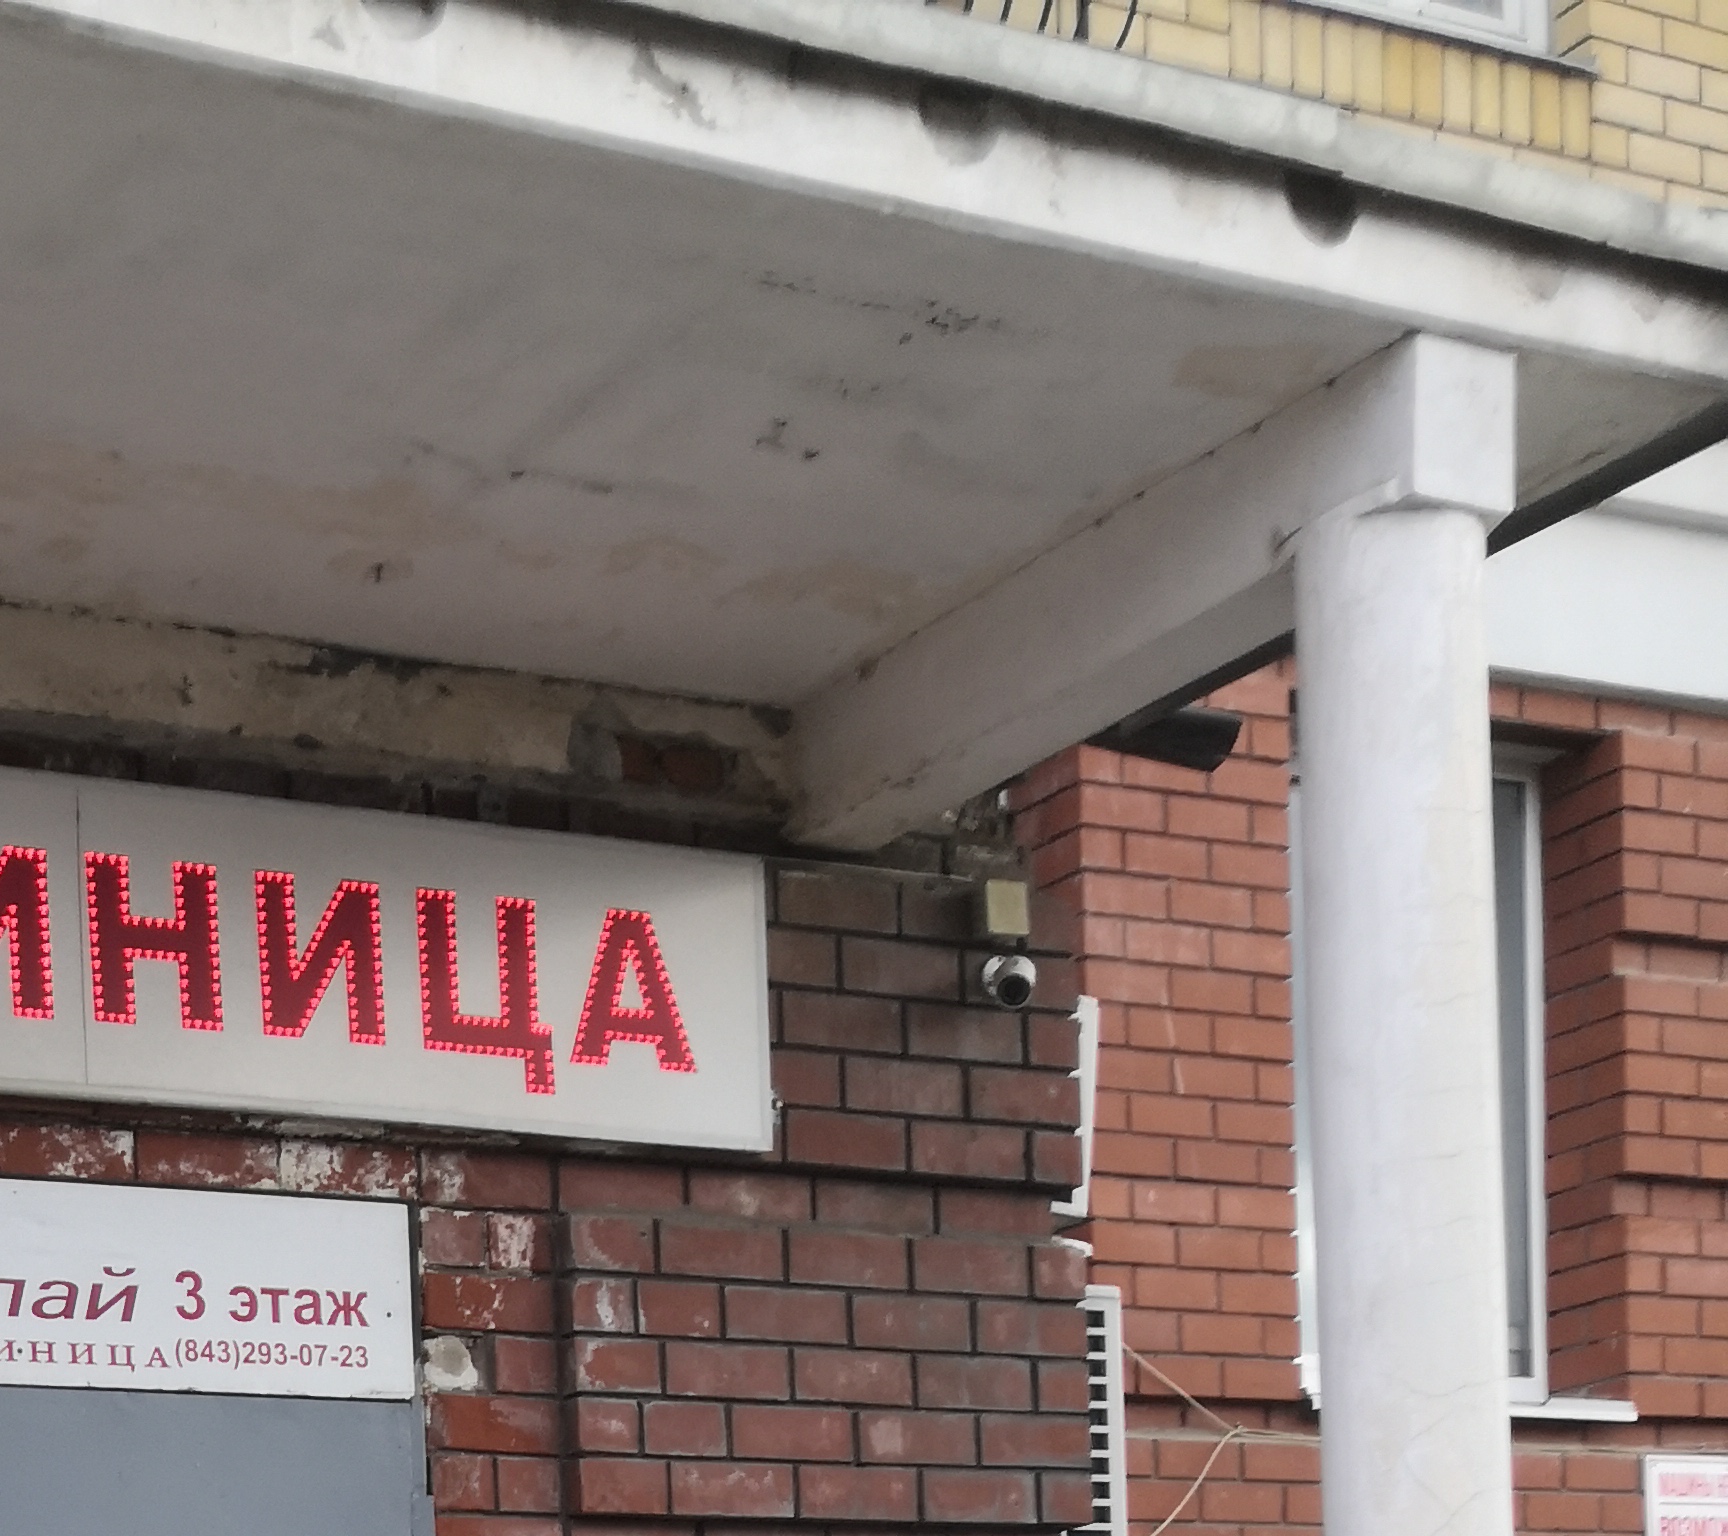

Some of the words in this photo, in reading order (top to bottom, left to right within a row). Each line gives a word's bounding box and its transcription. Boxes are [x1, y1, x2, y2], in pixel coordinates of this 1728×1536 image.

[174, 1269, 206, 1321] 3
[228, 1285, 369, 1327] этаж
[174, 1337, 369, 1370] (843)293-07-23
